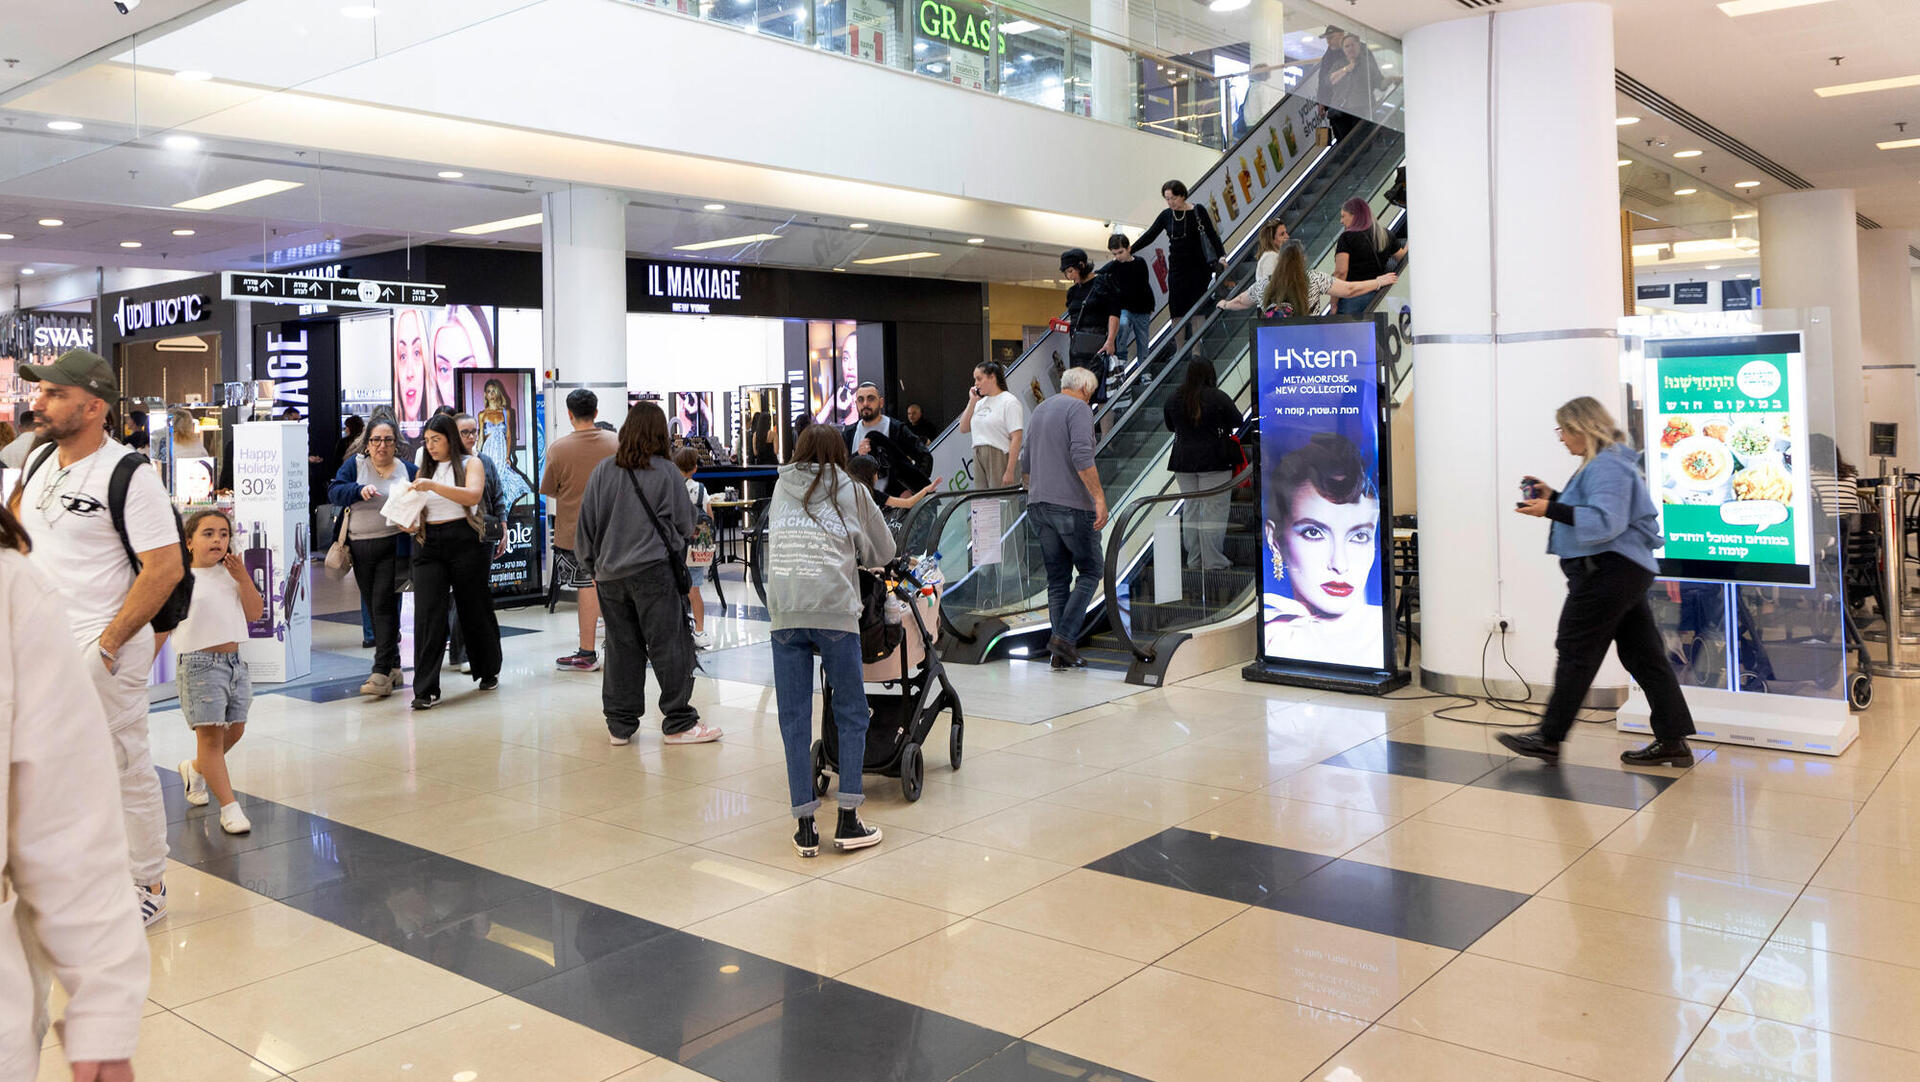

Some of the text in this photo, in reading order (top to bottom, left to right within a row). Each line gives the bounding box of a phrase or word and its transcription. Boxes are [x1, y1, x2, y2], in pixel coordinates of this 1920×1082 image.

[649, 264, 742, 300] IL MAKIAGE
[672, 302, 710, 313] NEW YORK
[1283, 374, 1350, 384] METAMORFOSE
[1275, 384, 1358, 395] NEW COLLECTION
[1284, 407, 1305, 417] קומה
[1339, 406, 1359, 415] חנות
[1665, 399, 1783, 412] במיקום חדש
[240, 447, 277, 461] Happy
[238, 463, 280, 477] Holiday
[241, 478, 276, 496] 30%
[283, 501, 307, 512] Collection
[1669, 531, 1790, 546] במתחם האוכל החדש
[1708, 546, 1749, 559] קומה 2
